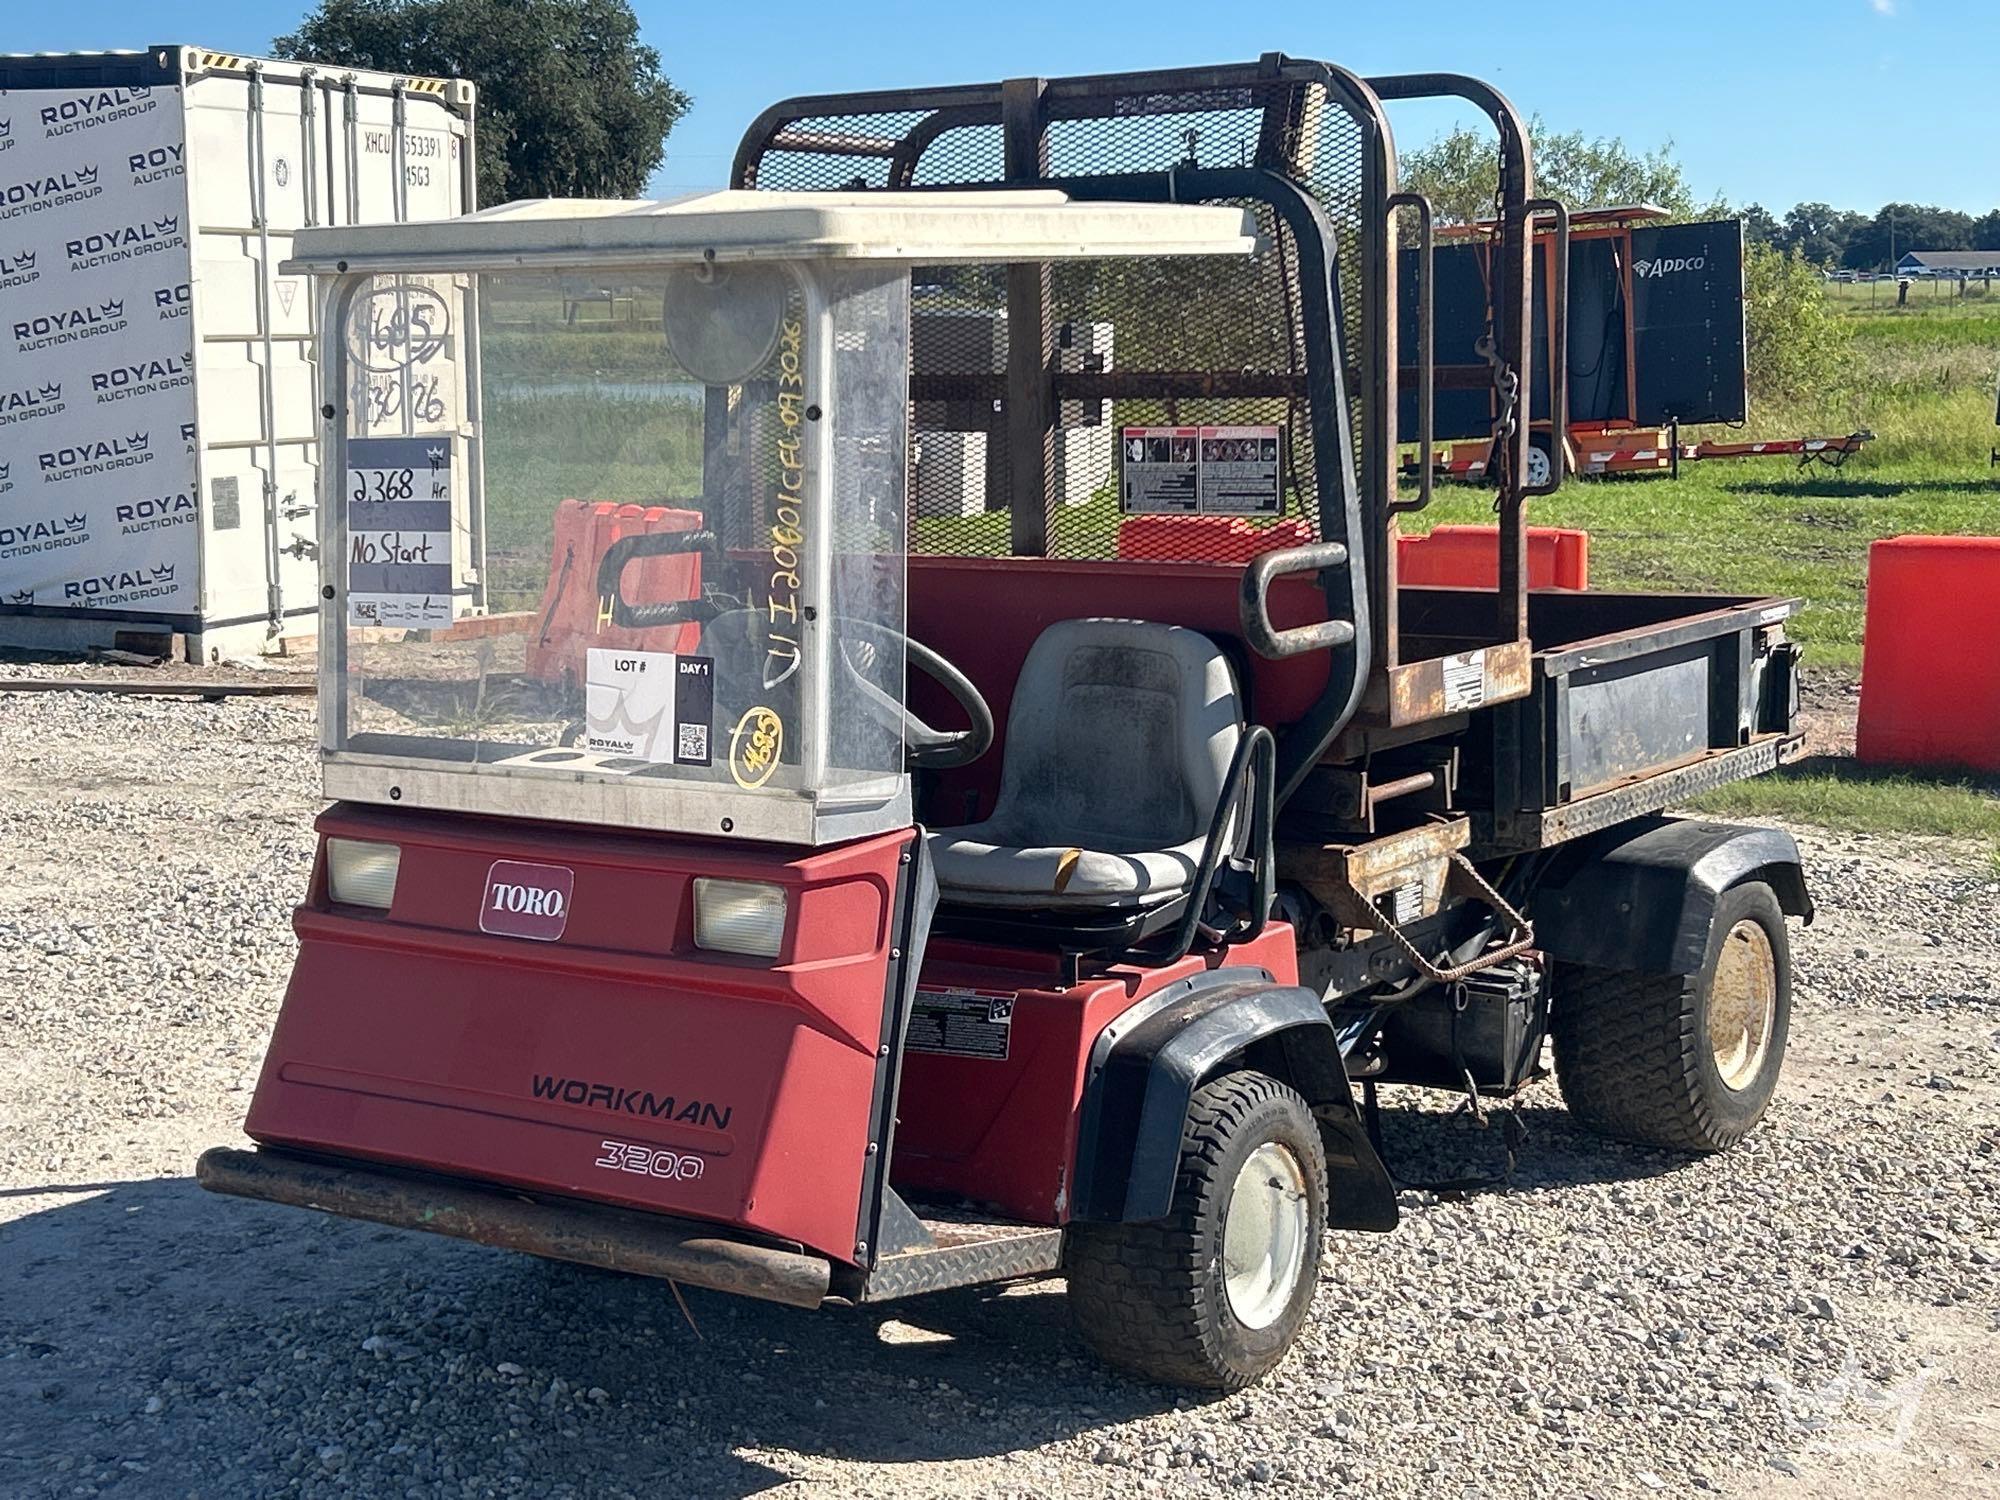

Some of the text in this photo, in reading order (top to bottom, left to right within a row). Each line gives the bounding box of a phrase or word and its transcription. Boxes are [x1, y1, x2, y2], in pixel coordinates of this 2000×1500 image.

[41, 89, 130, 125] ROYAL
[45, 100, 157, 139] AUCTION GROUP
[365, 131, 391, 154] XHCU
[0, 186, 103, 221] UCTION GROUP
[66, 224, 155, 259] ROYAL
[70, 236, 183, 272] AUCTION GROUP
[0, 271, 40, 290] ROUP
[1648, 257, 1705, 278] ADDCO
[13, 307, 102, 340] ROYAL
[18, 320, 128, 353] AUCTION GROUP
[91, 358, 183, 391] ROYAL
[97, 375, 194, 404] AUCTION GRO
[19, 403, 66, 421] GROUP
[39, 439, 128, 470] ROYAL
[44, 452, 154, 483] AUCTION GROUP
[122, 515, 183, 535] AUCTION
[44, 534, 90, 550] GROUP
[352, 532, 433, 565] No Start
[65, 570, 152, 598] ROYAL
[70, 584, 179, 609] AUCTION GROUP
[615, 659, 647, 672] LOT #
[680, 663, 708, 675] DAY 1
[589, 738, 624, 748] ROYAL
[492, 883, 563, 917] TORO
[532, 1074, 733, 1130] WORKMAN
[595, 1140, 705, 1181] 3200
